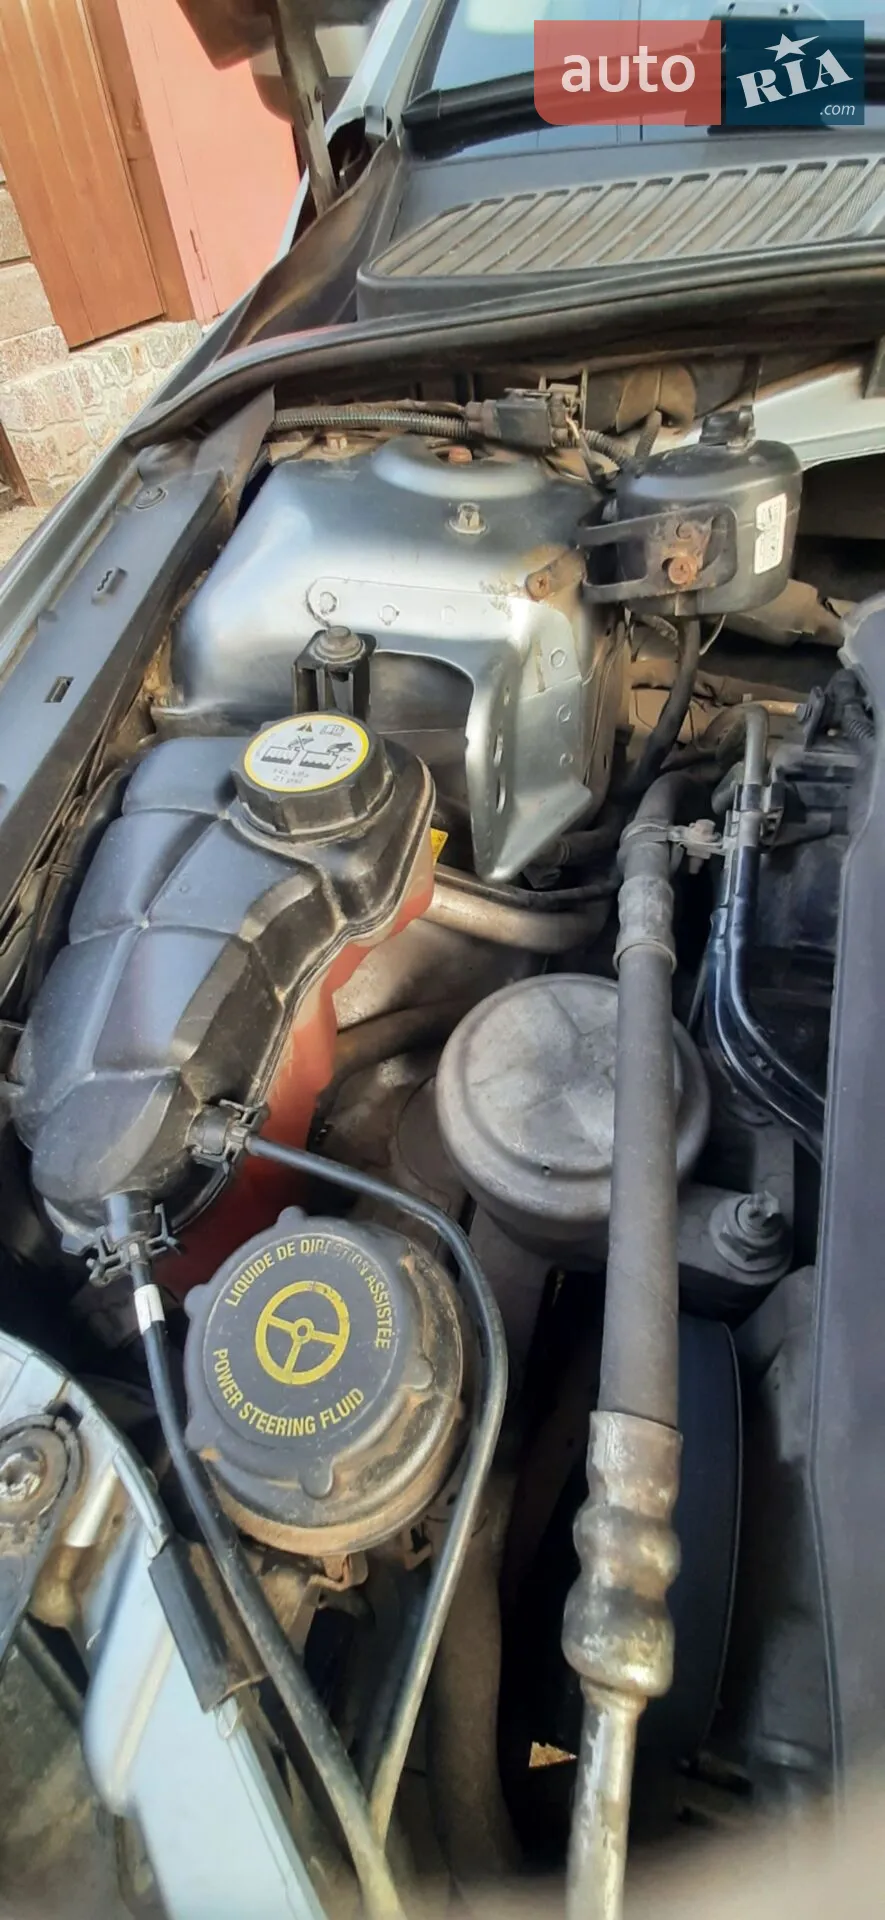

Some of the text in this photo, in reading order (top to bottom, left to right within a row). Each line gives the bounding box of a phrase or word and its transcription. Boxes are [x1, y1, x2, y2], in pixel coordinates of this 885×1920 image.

[224, 1251, 276, 1307] LIQUIDE
[276, 1241, 297, 1262] DE
[365, 1275, 395, 1350] ASSISTÉE
[212, 1347, 366, 1437] POWER STEERING FLUID
